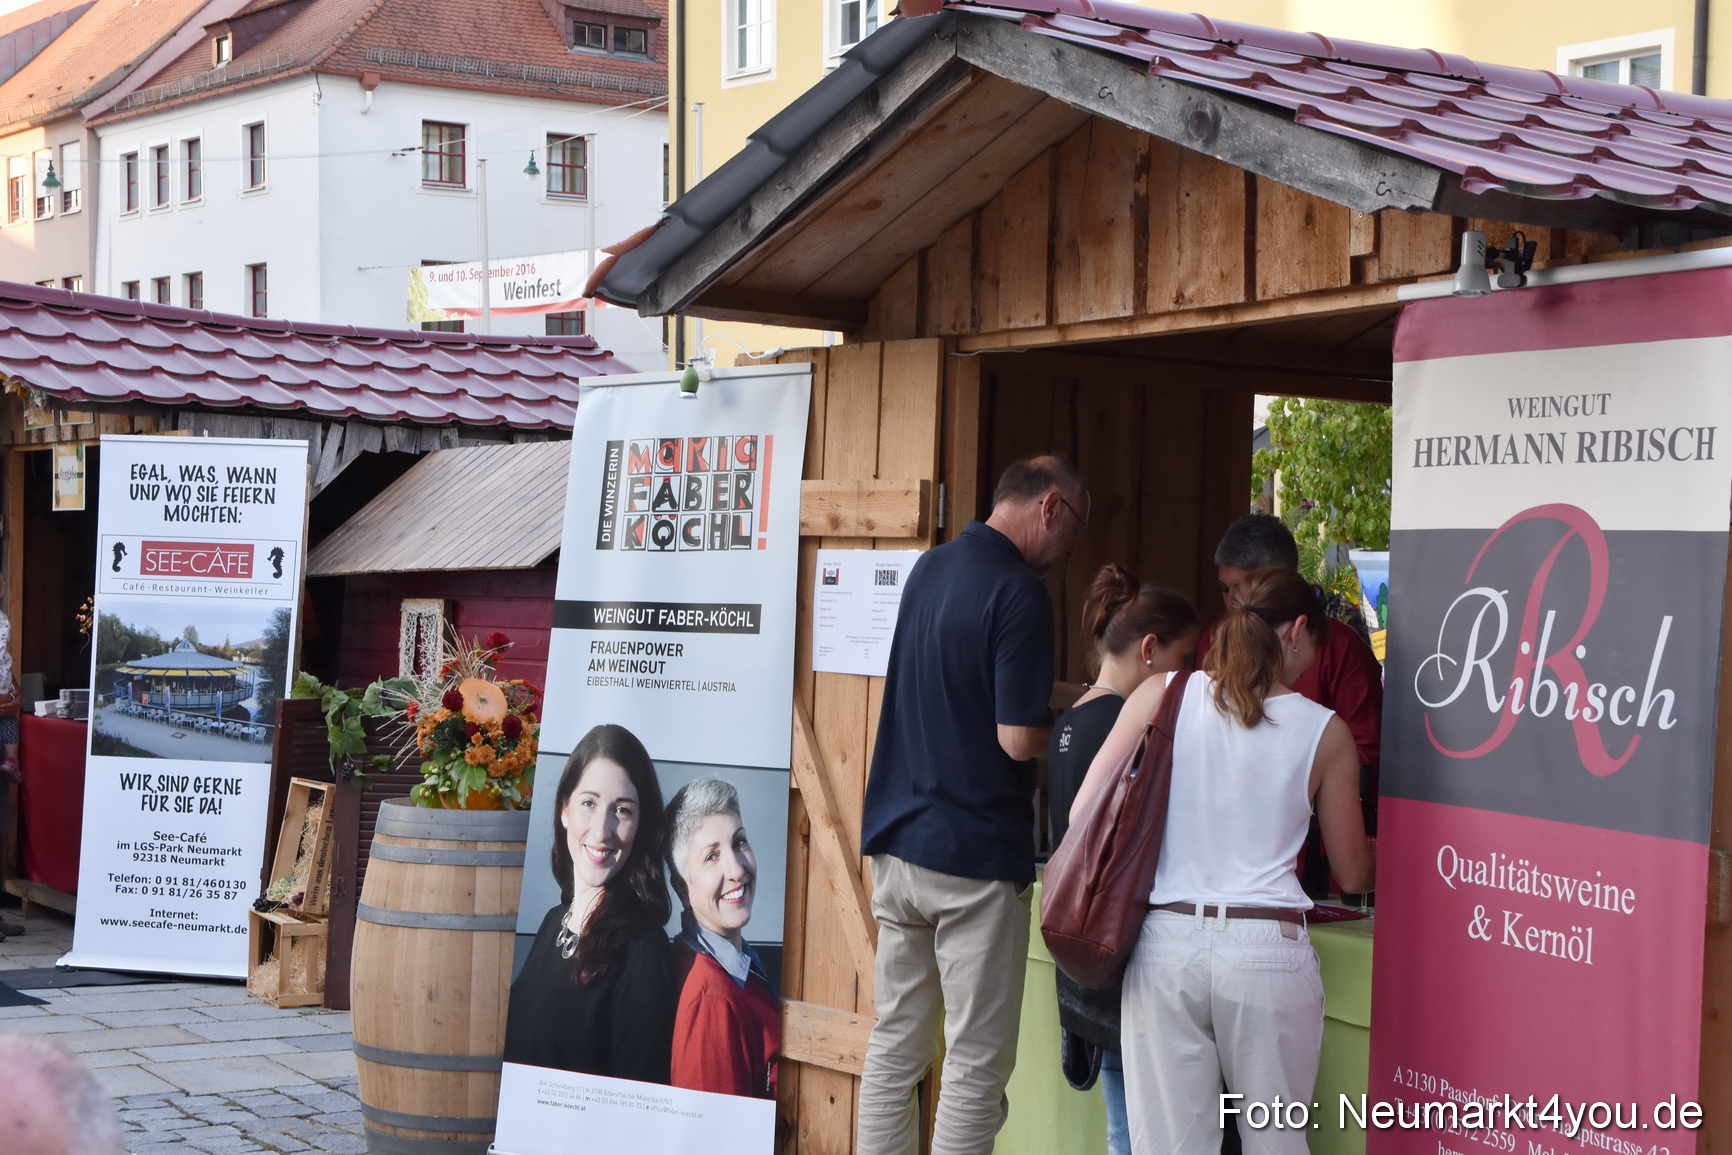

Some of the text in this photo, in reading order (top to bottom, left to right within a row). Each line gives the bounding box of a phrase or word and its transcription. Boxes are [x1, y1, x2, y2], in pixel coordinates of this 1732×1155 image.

[429, 263, 536, 283] 9. und 10. Sepember 2016
[503, 278, 562, 301] Weinfest
[1507, 393, 1611, 419] WEINGUT
[1412, 426, 1717, 468] HERMANN RIBISCH
[130, 463, 277, 485] EGAL, WAS, WANN
[129, 483, 276, 505] UND WO SIE FEIERN
[601, 447, 619, 542] DIE WINZERIN
[163, 501, 243, 524] MÖCHTEN:
[593, 608, 755, 628] WEINGUT FABER-KÖCHL
[589, 640, 684, 657] FRAUENPOWER
[1414, 586, 1678, 731] Ribisch
[588, 659, 666, 675] AM WEINGUT
[587, 676, 737, 693] EIBESTHAL WEINVIERTEL AUSTRIA
[120, 773, 243, 796] WIR SIND GERNE
[141, 788, 223, 815] FÜR SIE DA!
[117, 840, 242, 857] im LGS-Park Neumarkt
[153, 831, 208, 844] See-Café
[132, 853, 226, 867] 92318 Neumarkt
[107, 873, 247, 890] Telefon: 0 91 81/460130
[308, 885, 320, 907] Wein
[315, 869, 323, 884] aus
[1436, 844, 1636, 914] Qualitätsweine
[115, 884, 238, 901] Fax: 0 91 81/26 35 87
[149, 908, 199, 920] Internet:
[100, 916, 248, 935] www.seecafe-neumarkt.de
[1467, 904, 1594, 965] & Kernöl
[1393, 1066, 1403, 1085] A
[1406, 1068, 1437, 1094] 2130
